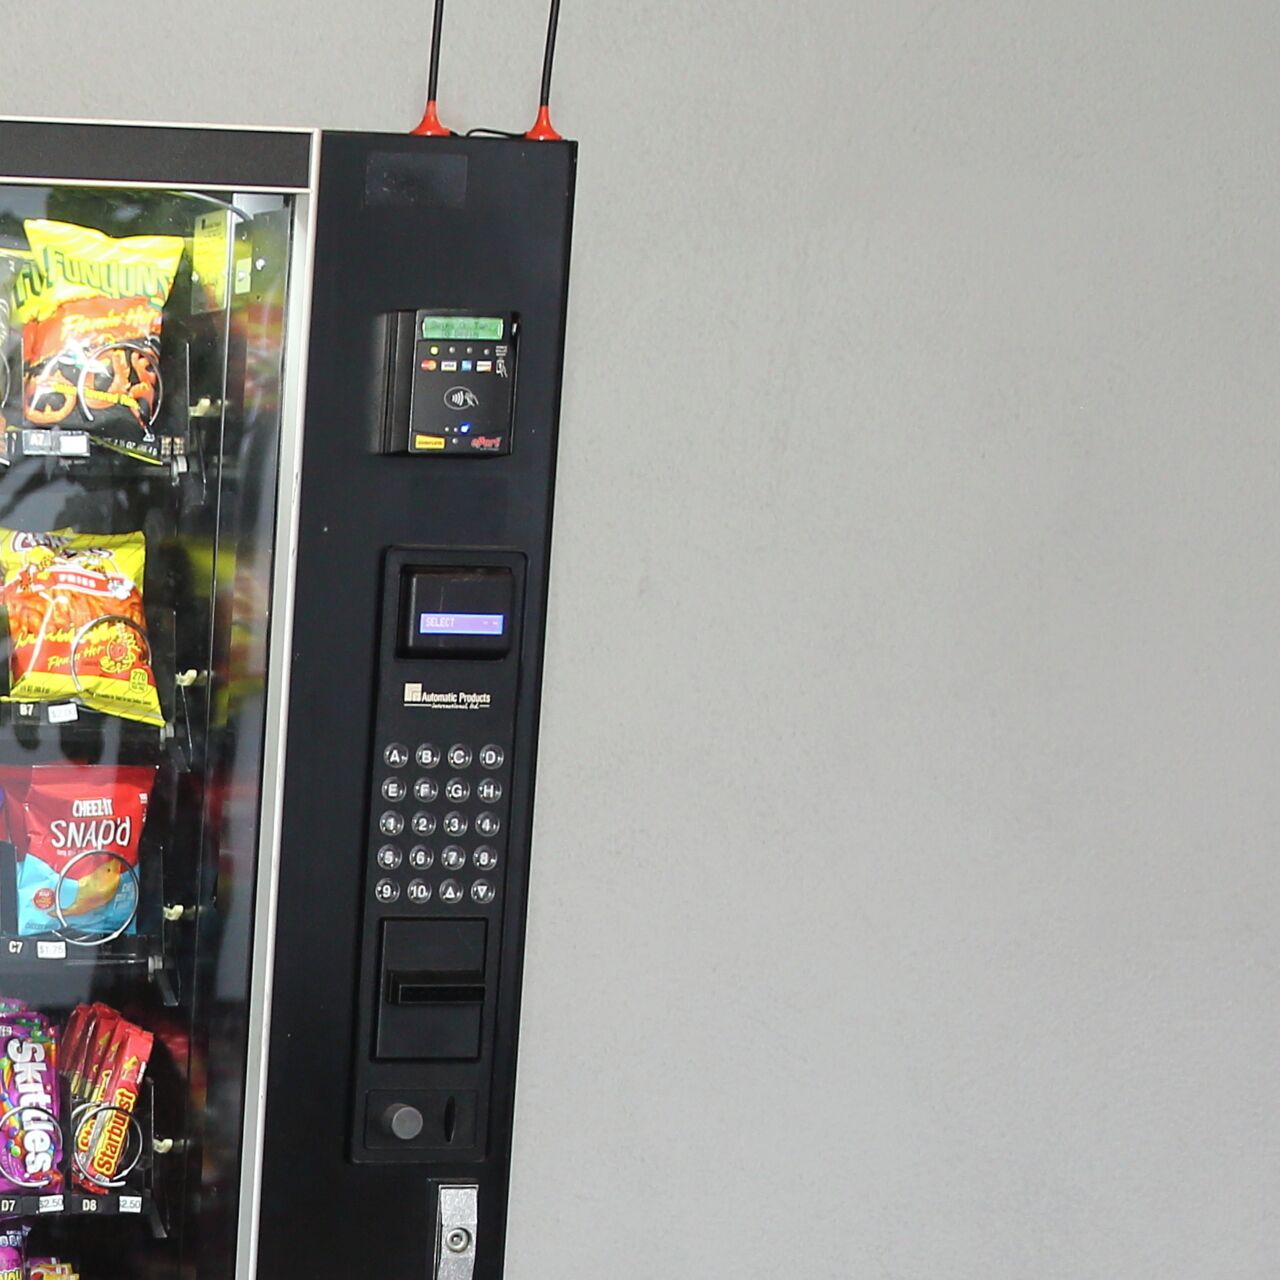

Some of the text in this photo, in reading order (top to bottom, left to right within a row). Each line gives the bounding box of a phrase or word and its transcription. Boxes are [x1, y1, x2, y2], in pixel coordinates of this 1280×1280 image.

[425, 617, 454, 627] SELECT
[132, 671, 146, 682] 270
[422, 692, 491, 703] Automatic Products
[390, 750, 495, 763] A B C D
[388, 784, 493, 797] E F G H
[418, 819, 427, 830] 2
[450, 819, 458, 831] 3
[481, 820, 490, 831] 4
[384, 852, 488, 864] 5 6 7 8
[382, 885, 426, 898] 9 10
[9, 941, 24, 953] C7
[94, 1087, 136, 1174] Starburst
[1, 1200, 16, 1212] D7
[82, 1200, 97, 1212] D8
